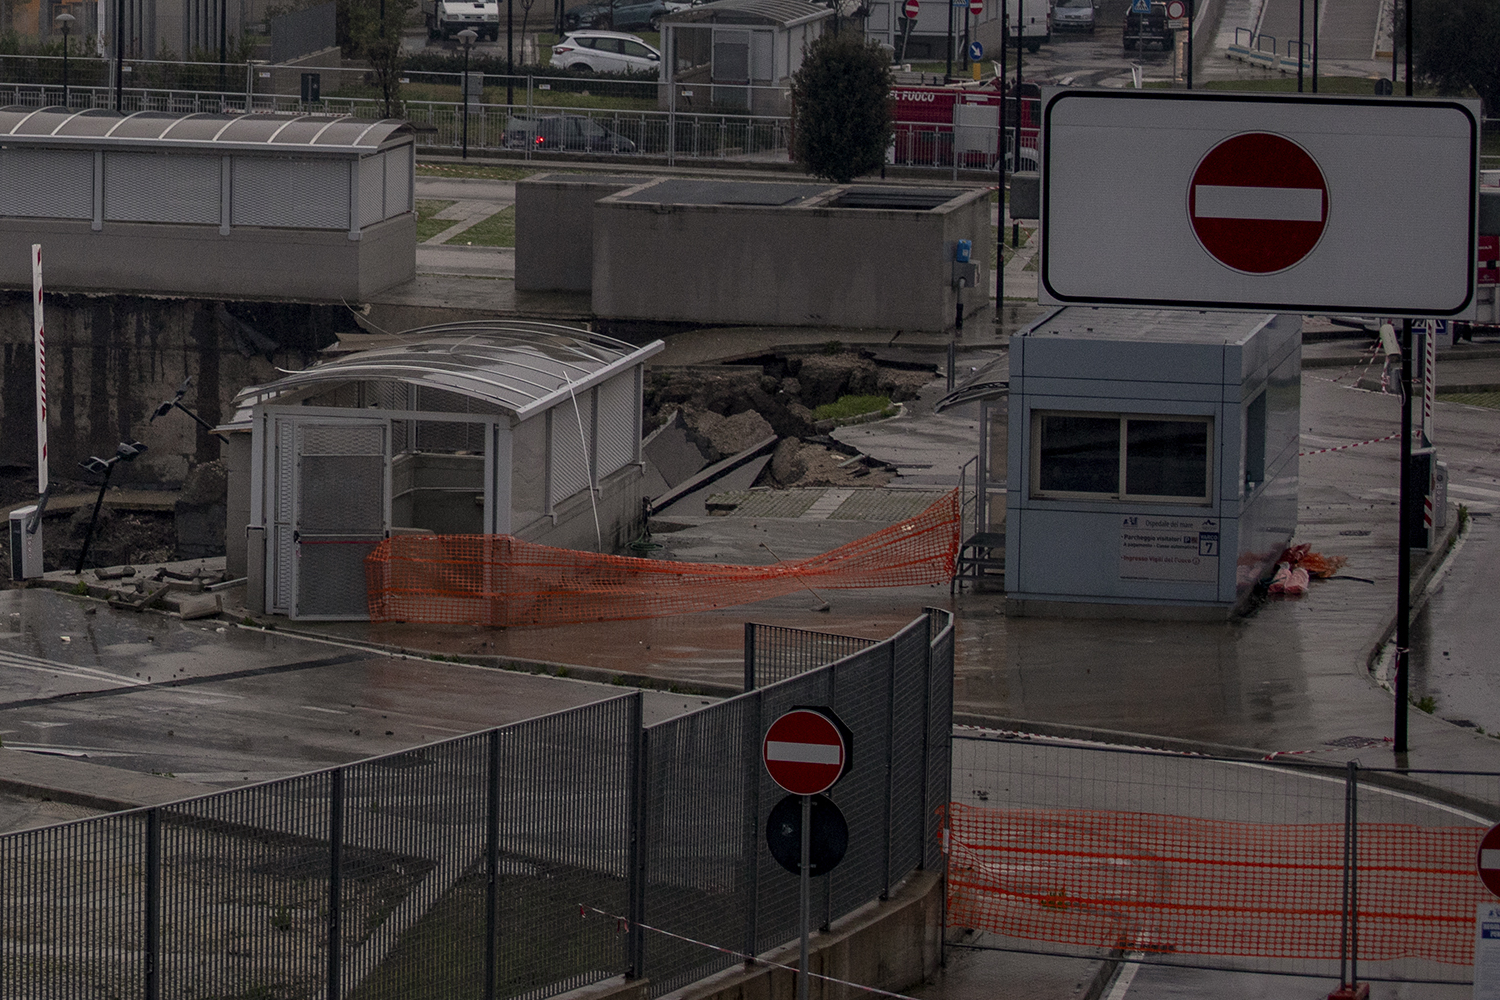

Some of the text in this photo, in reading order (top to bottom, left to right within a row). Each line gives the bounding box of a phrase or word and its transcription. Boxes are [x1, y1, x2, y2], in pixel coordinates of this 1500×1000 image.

[902, 91, 935, 102] FUOCO
[1145, 519, 1170, 528] Ospedale
[1124, 534, 1156, 542] Parcheggio
[1205, 542, 1213, 553] 7
[1123, 555, 1148, 563] Ingresso
[1174, 556, 1192, 564] Fuoco
